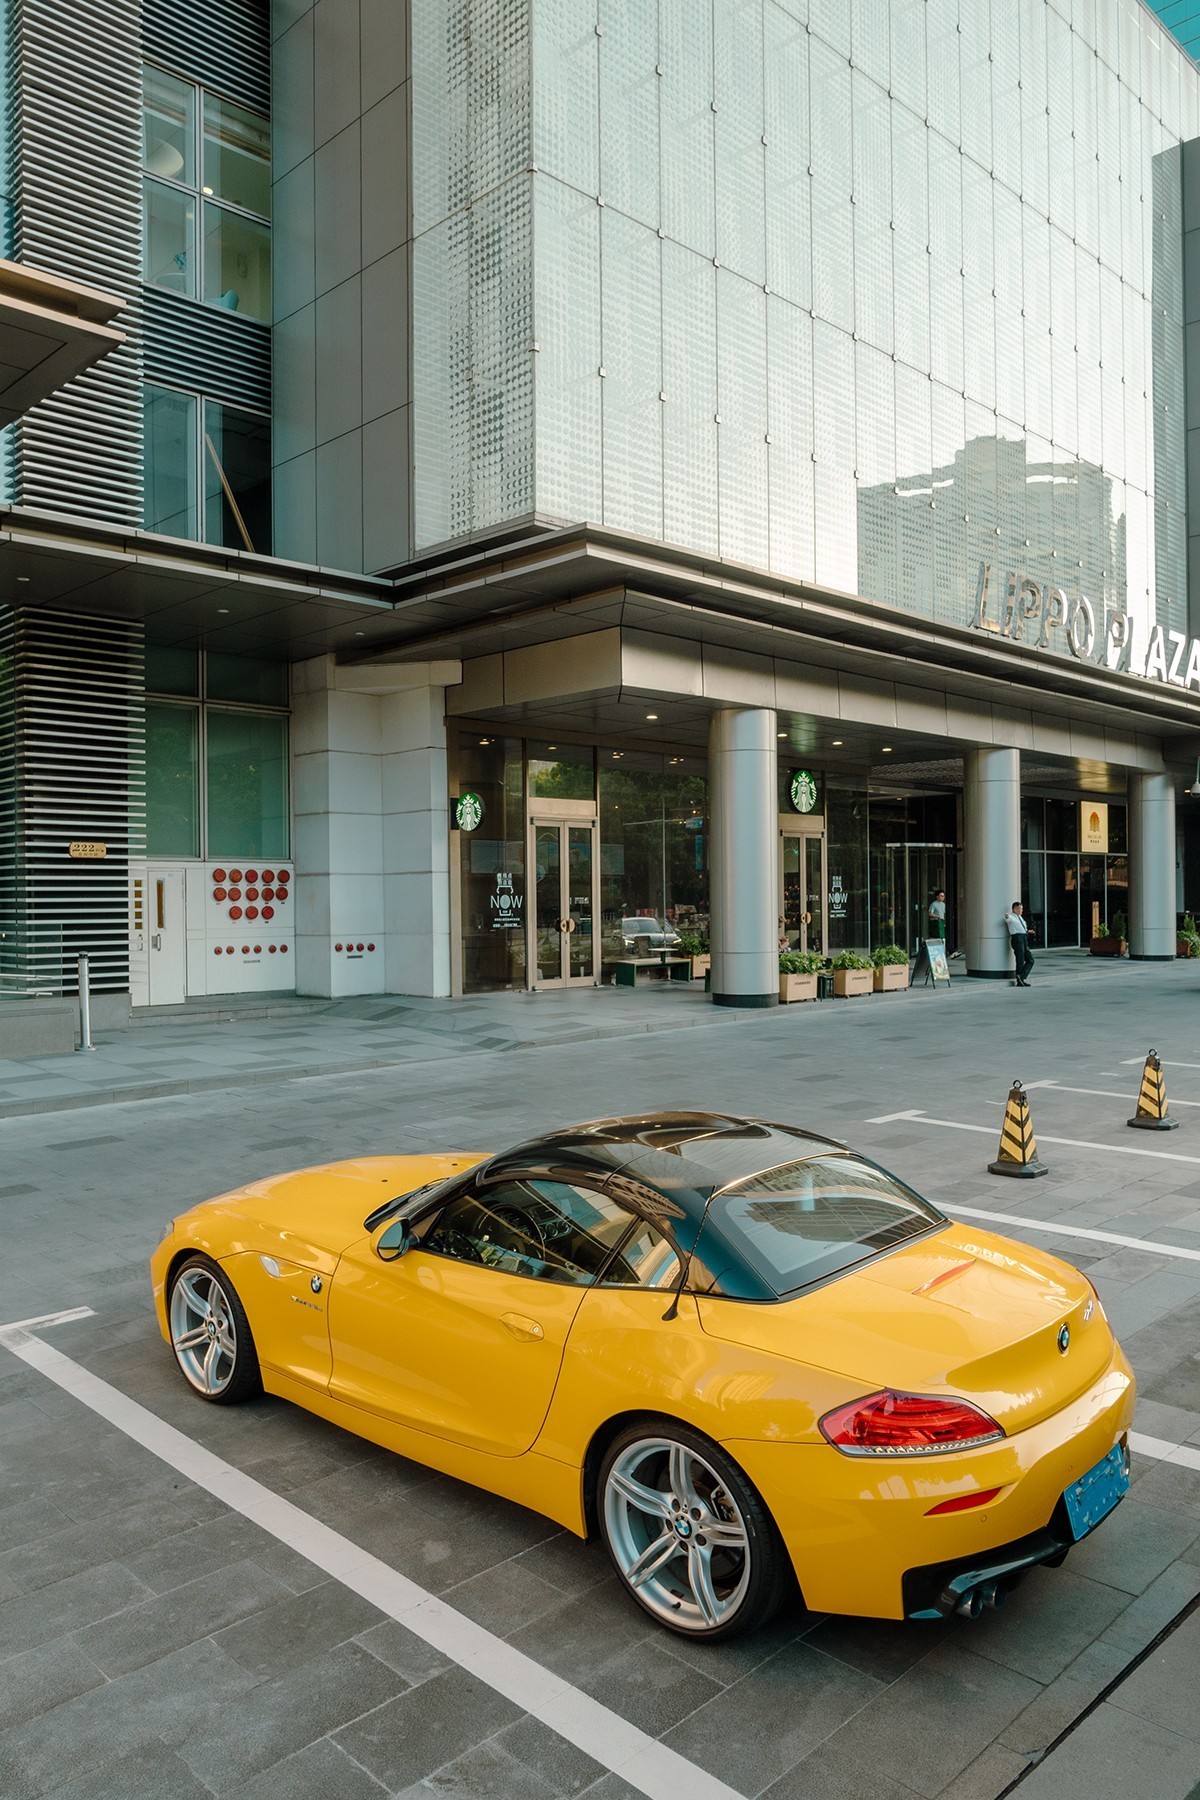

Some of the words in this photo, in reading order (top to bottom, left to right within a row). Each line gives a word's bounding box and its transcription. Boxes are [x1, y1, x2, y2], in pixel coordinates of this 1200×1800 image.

[974, 561, 1095, 658] LIPPO
[1103, 608, 1200, 692] PLAZA
[490, 894, 523, 909] NOW
[828, 892, 848, 904] NOW
